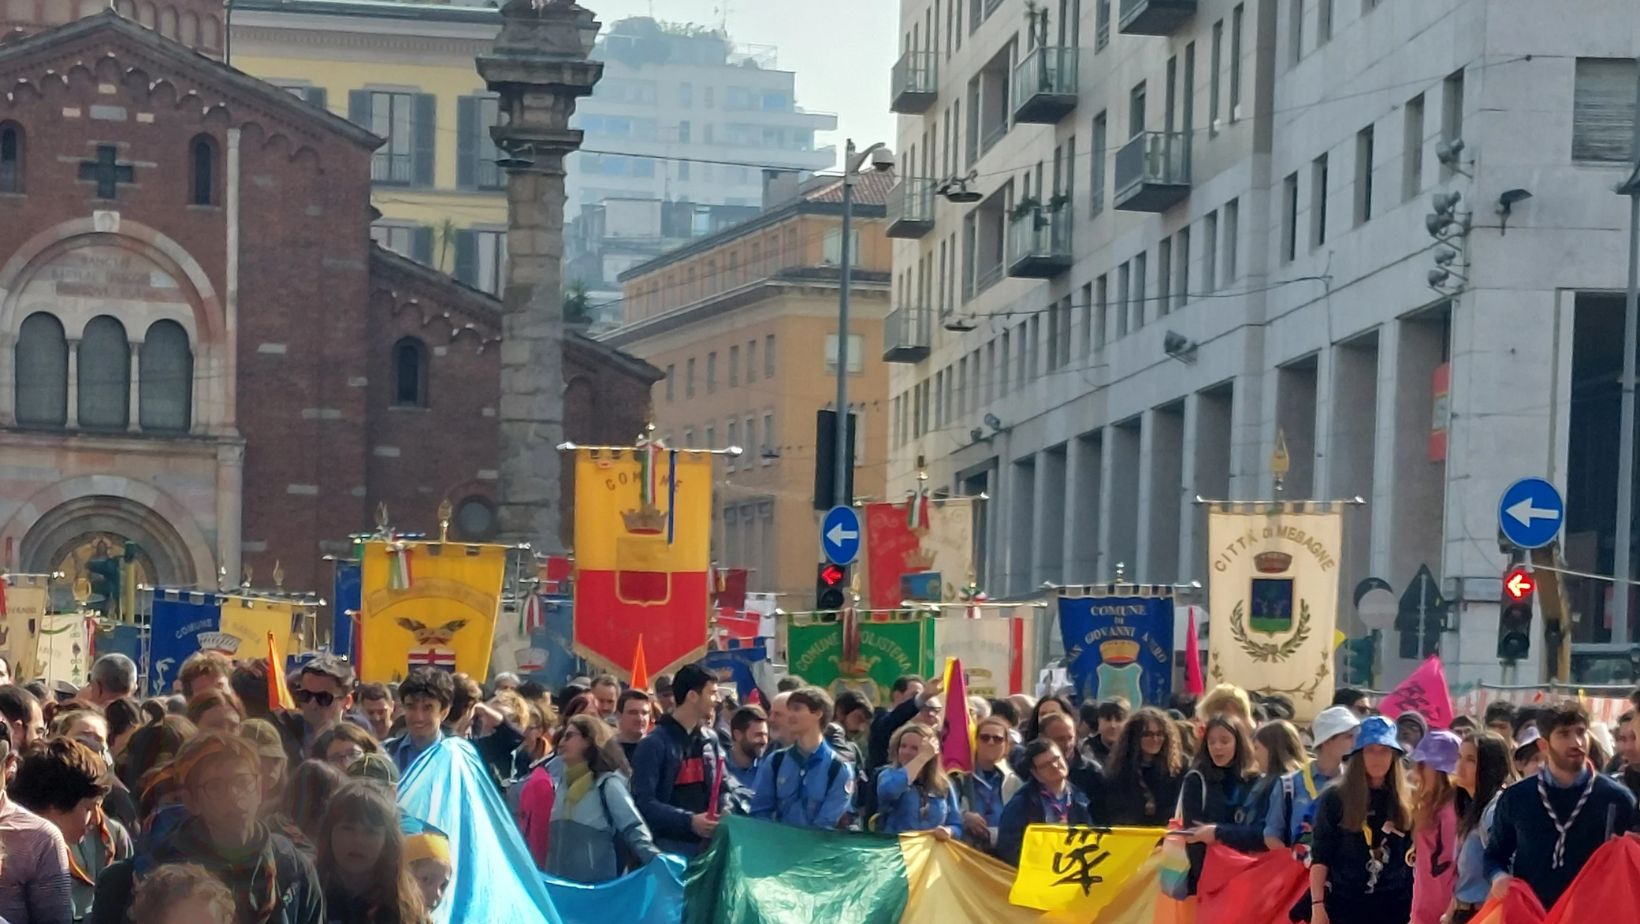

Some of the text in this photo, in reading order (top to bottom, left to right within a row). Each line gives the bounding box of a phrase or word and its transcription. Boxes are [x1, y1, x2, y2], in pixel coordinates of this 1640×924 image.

[605, 472, 684, 492] COMNE
[1090, 605, 1148, 617] COMUNE
[175, 618, 213, 639] COMUNE
[1084, 626, 1136, 645] GIOVANNI
[795, 631, 912, 672] COMUNE OLISTENA
